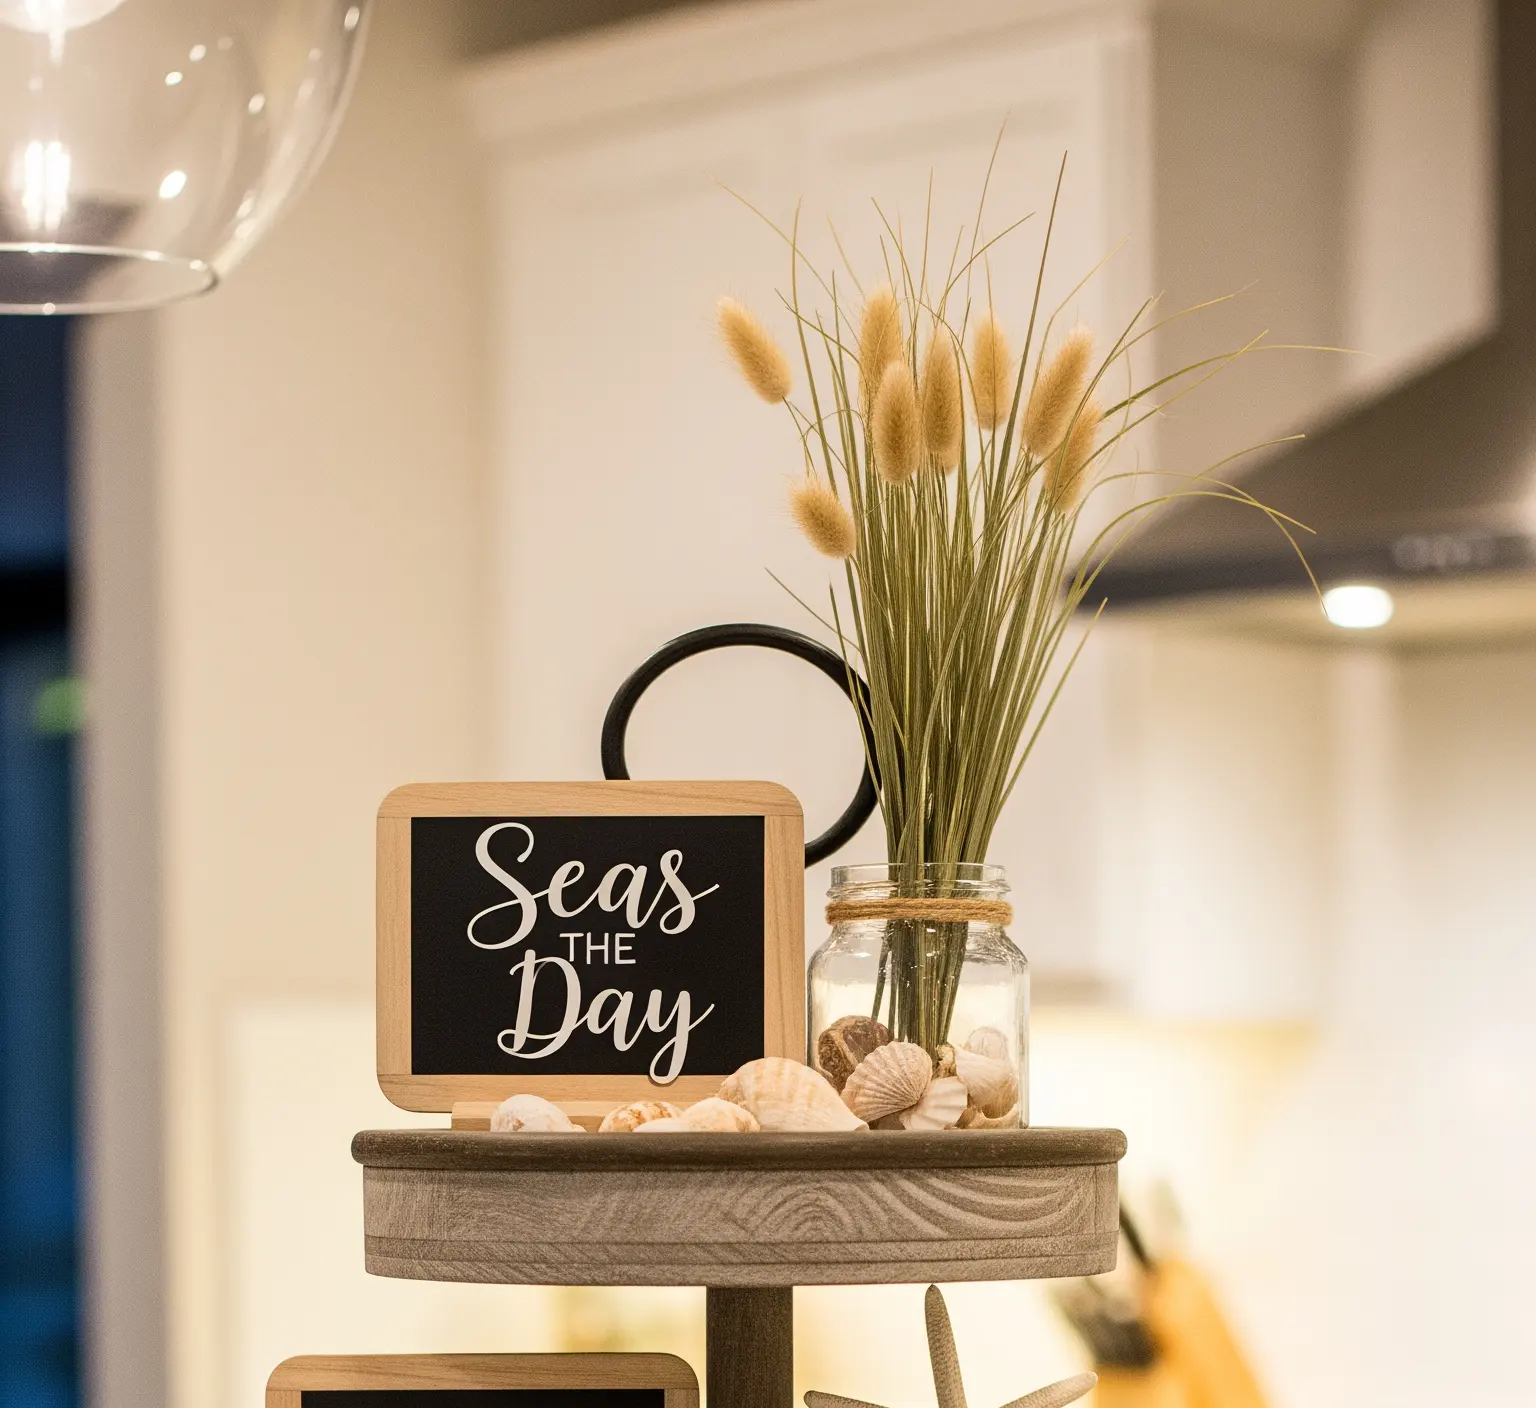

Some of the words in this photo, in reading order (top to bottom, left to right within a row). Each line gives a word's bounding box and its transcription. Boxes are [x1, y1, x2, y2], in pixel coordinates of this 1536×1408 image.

[466, 822, 720, 950] Seas
[559, 932, 637, 965] THE
[496, 949, 716, 1085] Day
